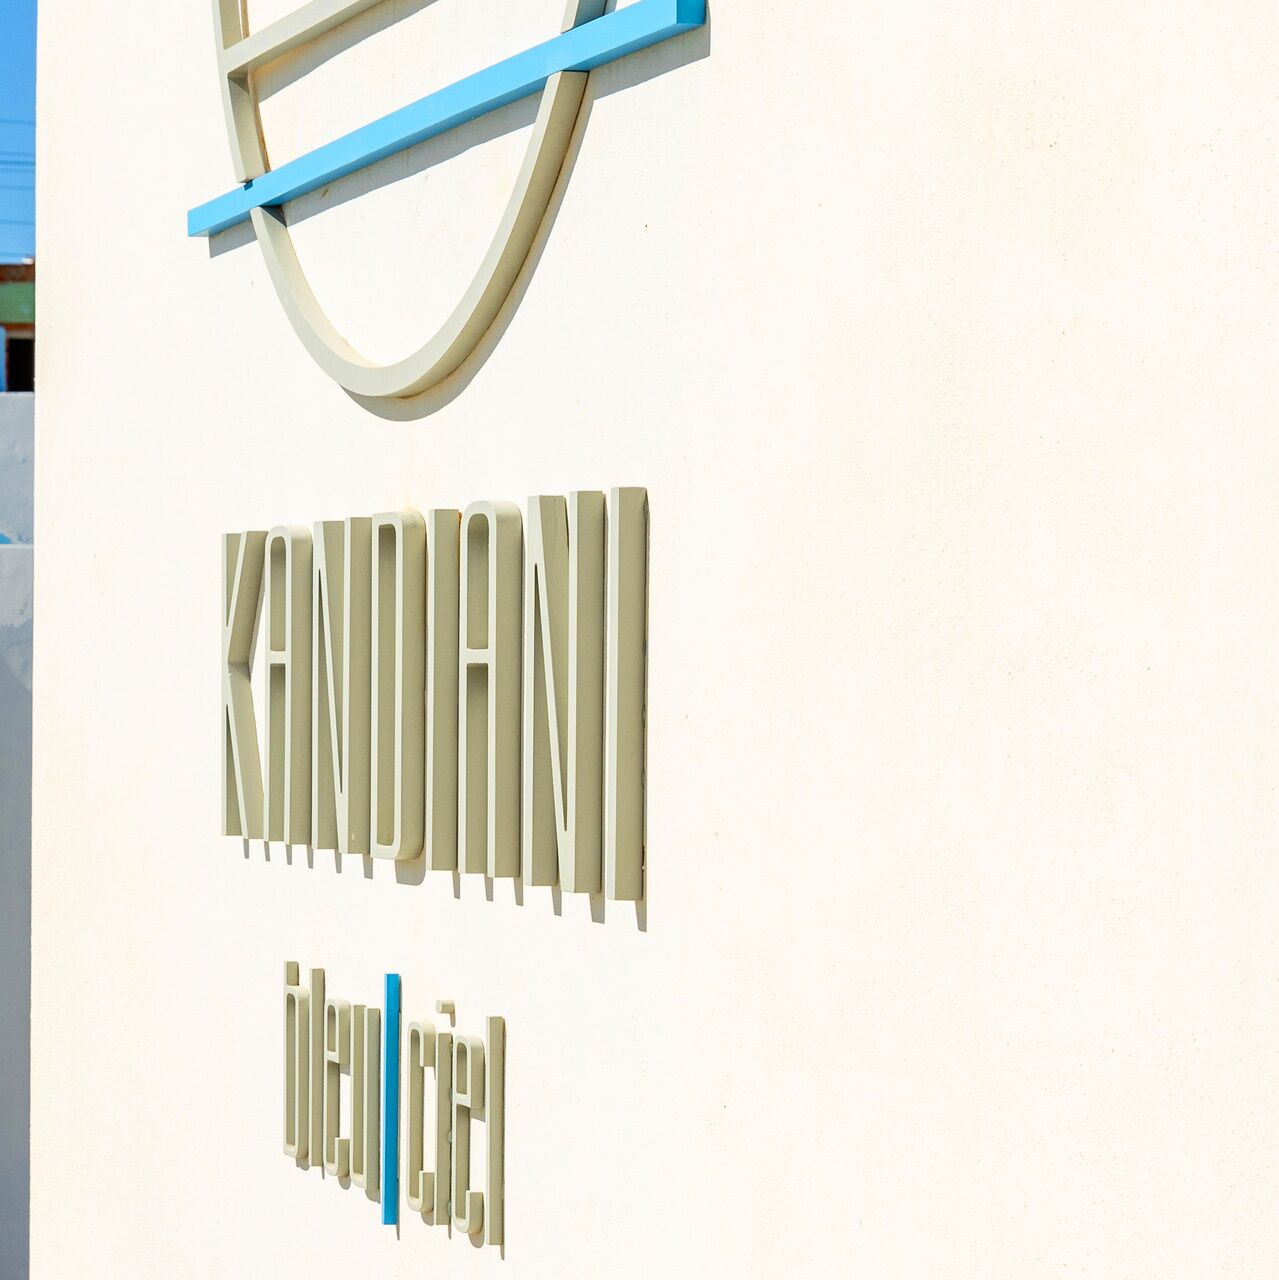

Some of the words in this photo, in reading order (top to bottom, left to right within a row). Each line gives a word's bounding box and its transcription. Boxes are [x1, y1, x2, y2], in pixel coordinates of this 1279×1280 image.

[222, 486, 648, 902] KANDIANI
[284, 961, 381, 1193] bleu
[407, 1000, 505, 1246] ciel
